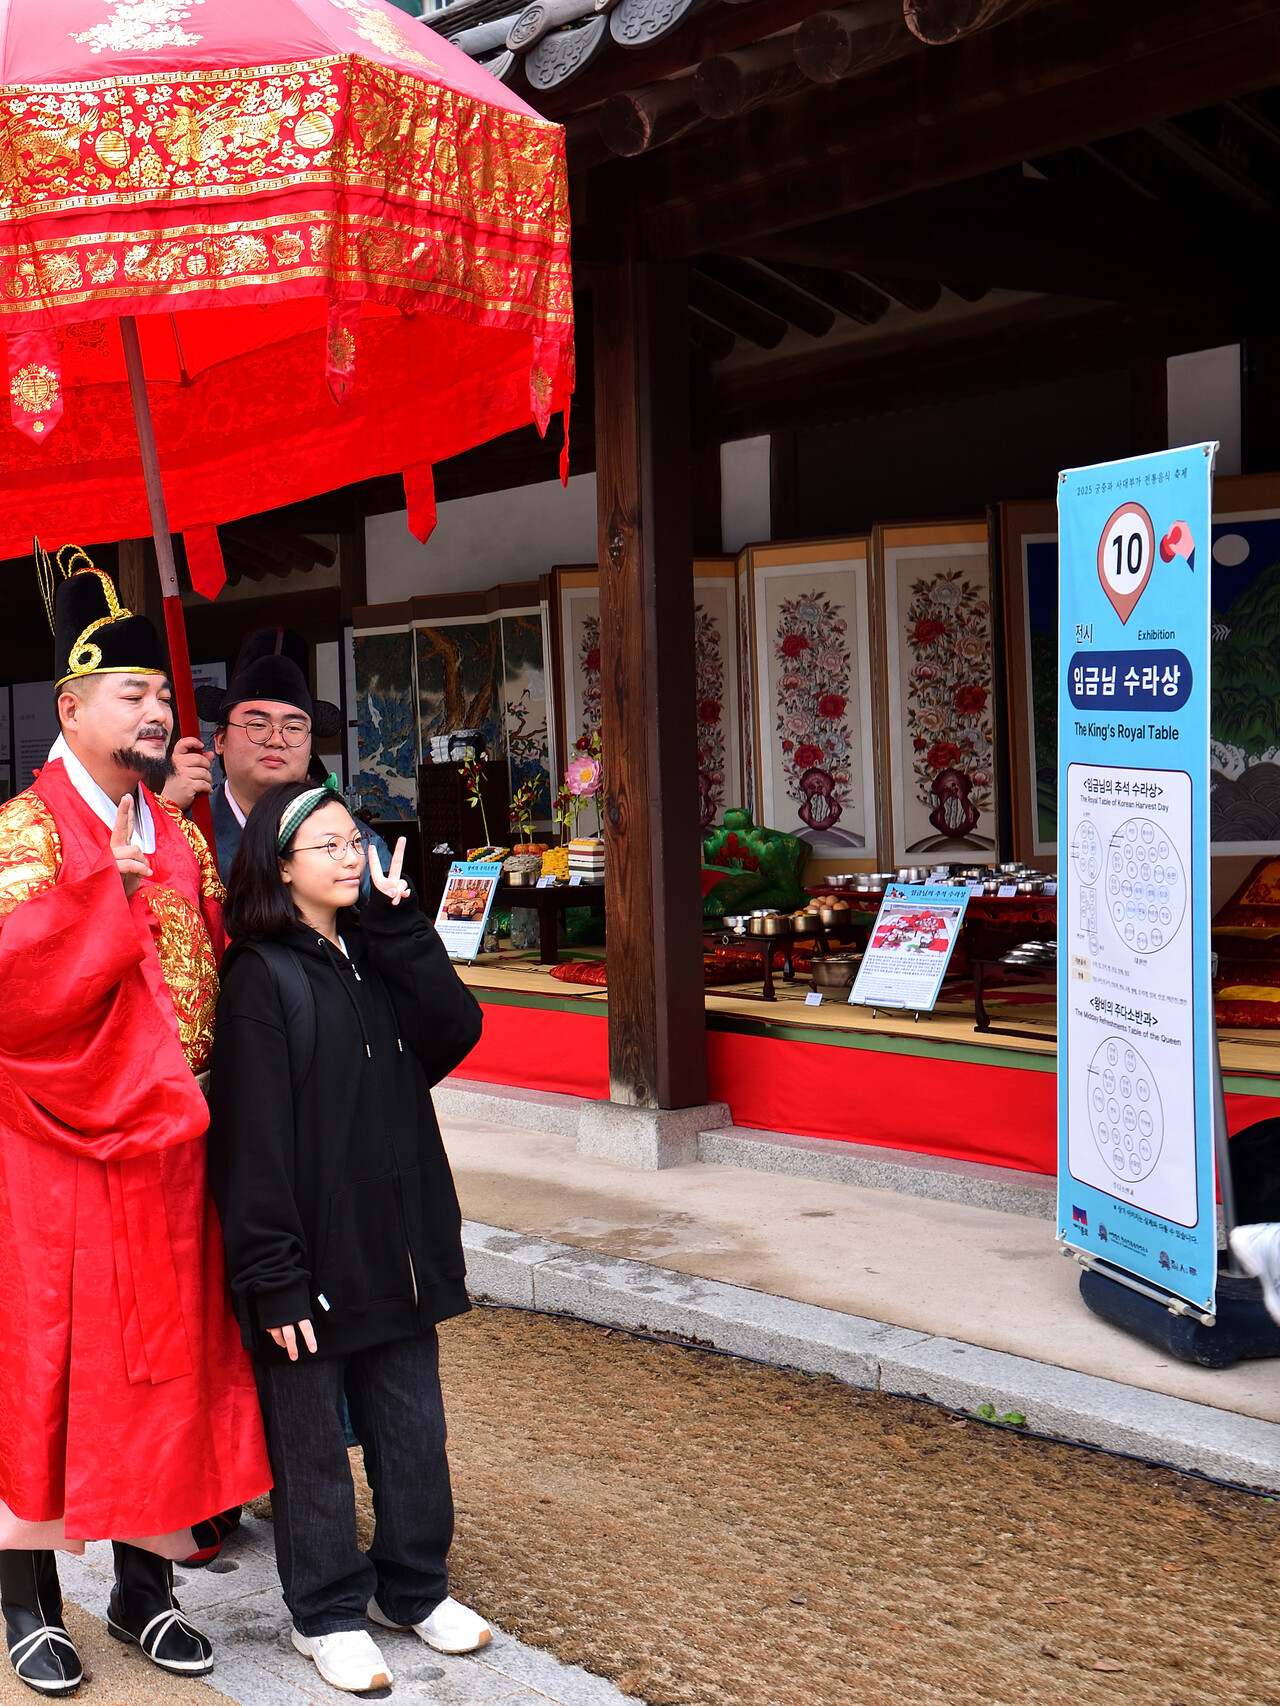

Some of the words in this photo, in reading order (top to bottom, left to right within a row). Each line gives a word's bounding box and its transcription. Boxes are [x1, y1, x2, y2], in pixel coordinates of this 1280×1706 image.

[1077, 485, 1092, 496] 2025
[1095, 481, 1113, 494] 궁중과
[1115, 476, 1141, 490] 사대부가
[1144, 470, 1171, 486] 전통음식
[1174, 467, 1188, 479] 축제
[1112, 532, 1144, 576] 10
[1075, 623, 1093, 644] 전시
[1138, 629, 1176, 641] Exhibition
[1074, 665, 1116, 696] 임금님
[1123, 664, 1181, 697] 수라상
[1074, 722, 1087, 737] The
[1088, 723, 1116, 741] King's
[1118, 724, 1146, 742] Royal
[1148, 724, 1180, 740] Table
[1114, 780, 1130, 796] 추석
[1080, 795, 1088, 803] The
[1088, 796, 1098, 806] Royal
[1099, 796, 1111, 806] Table
[1112, 798, 1117, 807] of
[1118, 799, 1134, 808] Korean
[1136, 801, 1157, 810] Harvest
[1158, 803, 1170, 813] Day
[1090, 996, 1114, 1016] <왕비의
[1114, 1004, 1158, 1028] 주다소반과>
[1074, 1008, 1083, 1016] The
[1084, 1010, 1099, 1024] Midday
[1128, 1026, 1142, 1036] Table
[1142, 1030, 1149, 1038] of
[1150, 1032, 1160, 1042] the
[1160, 1034, 1182, 1046] Queen
